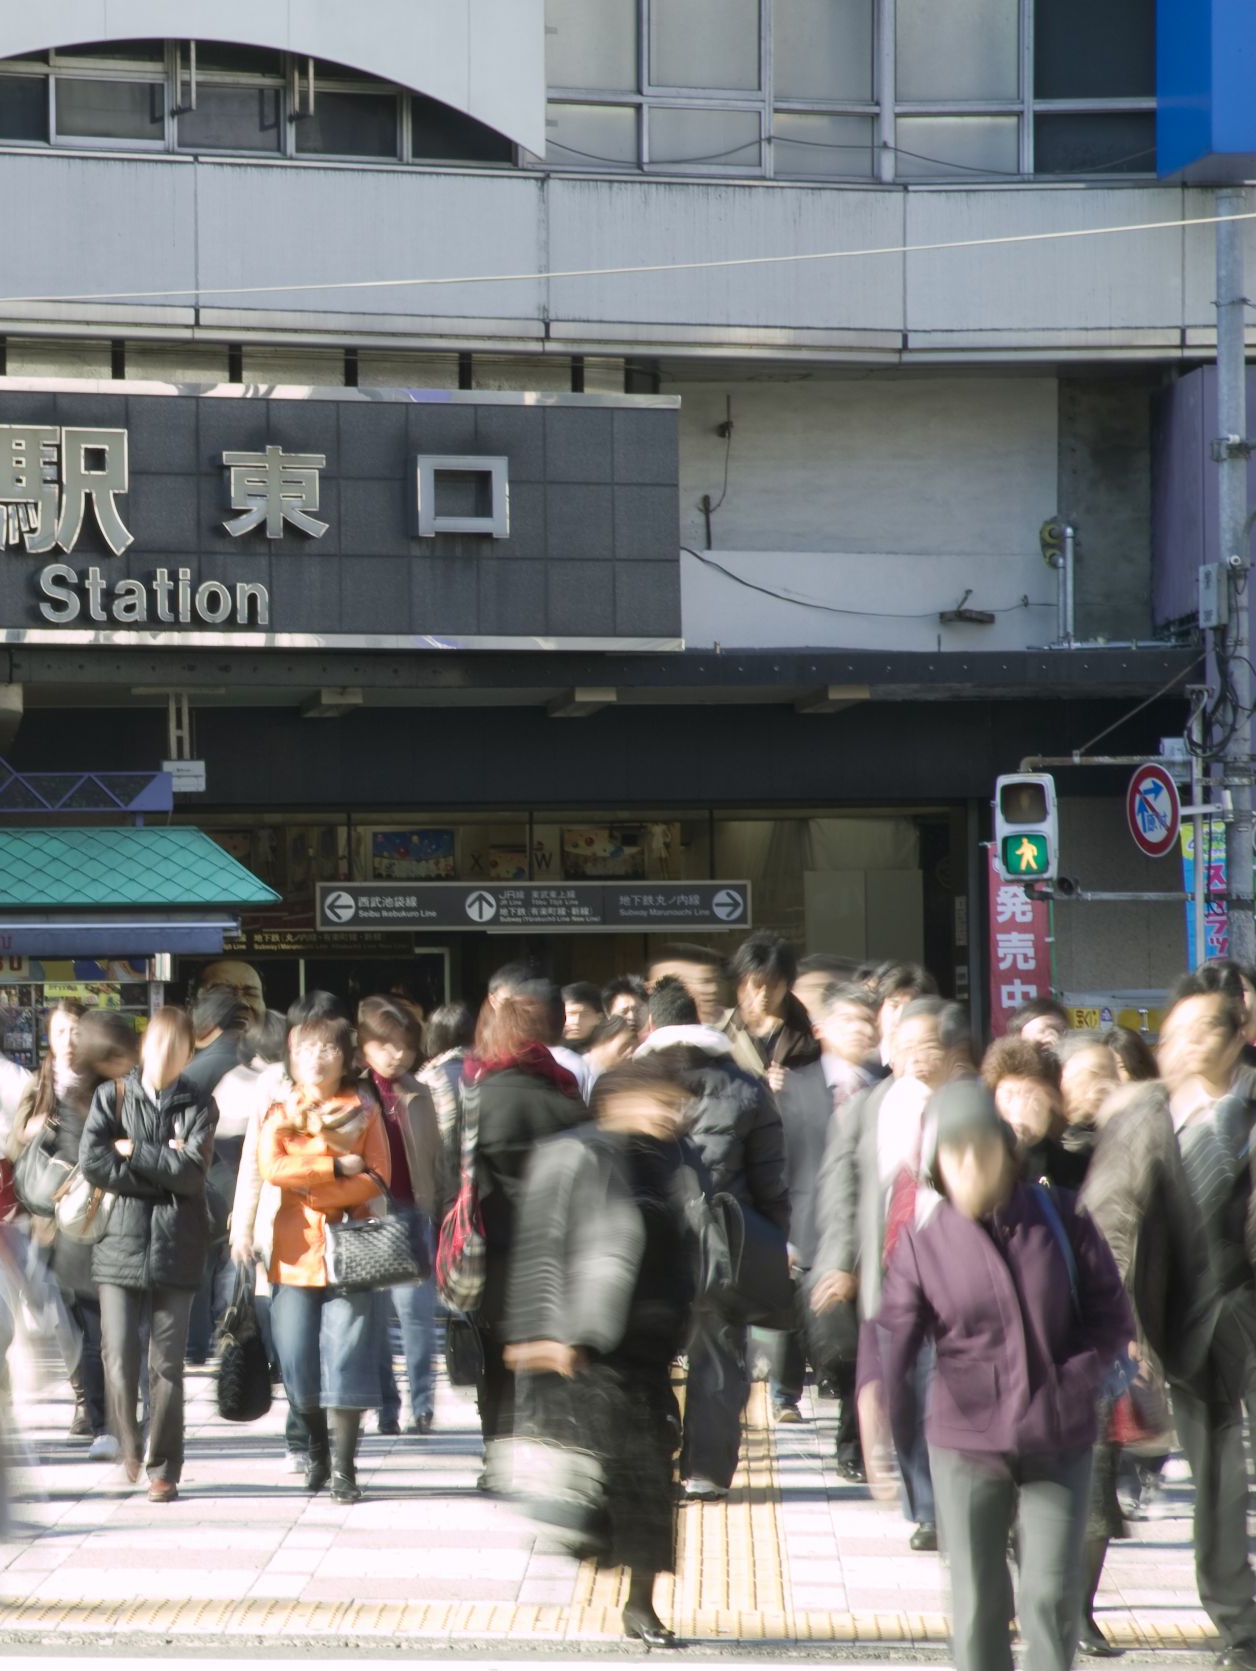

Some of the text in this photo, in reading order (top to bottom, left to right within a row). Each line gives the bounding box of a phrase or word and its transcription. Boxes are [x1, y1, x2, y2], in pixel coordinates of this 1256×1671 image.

[38, 562, 270, 625] Station
[357, 896, 418, 908] 西武池袋線
[618, 894, 701, 906] 地下鉄丸ノ内線
[420, 909, 437, 918] Line
[619, 908, 648, 918] Subway
[694, 908, 710, 917] Line
[996, 885, 1038, 1010] 発売中
